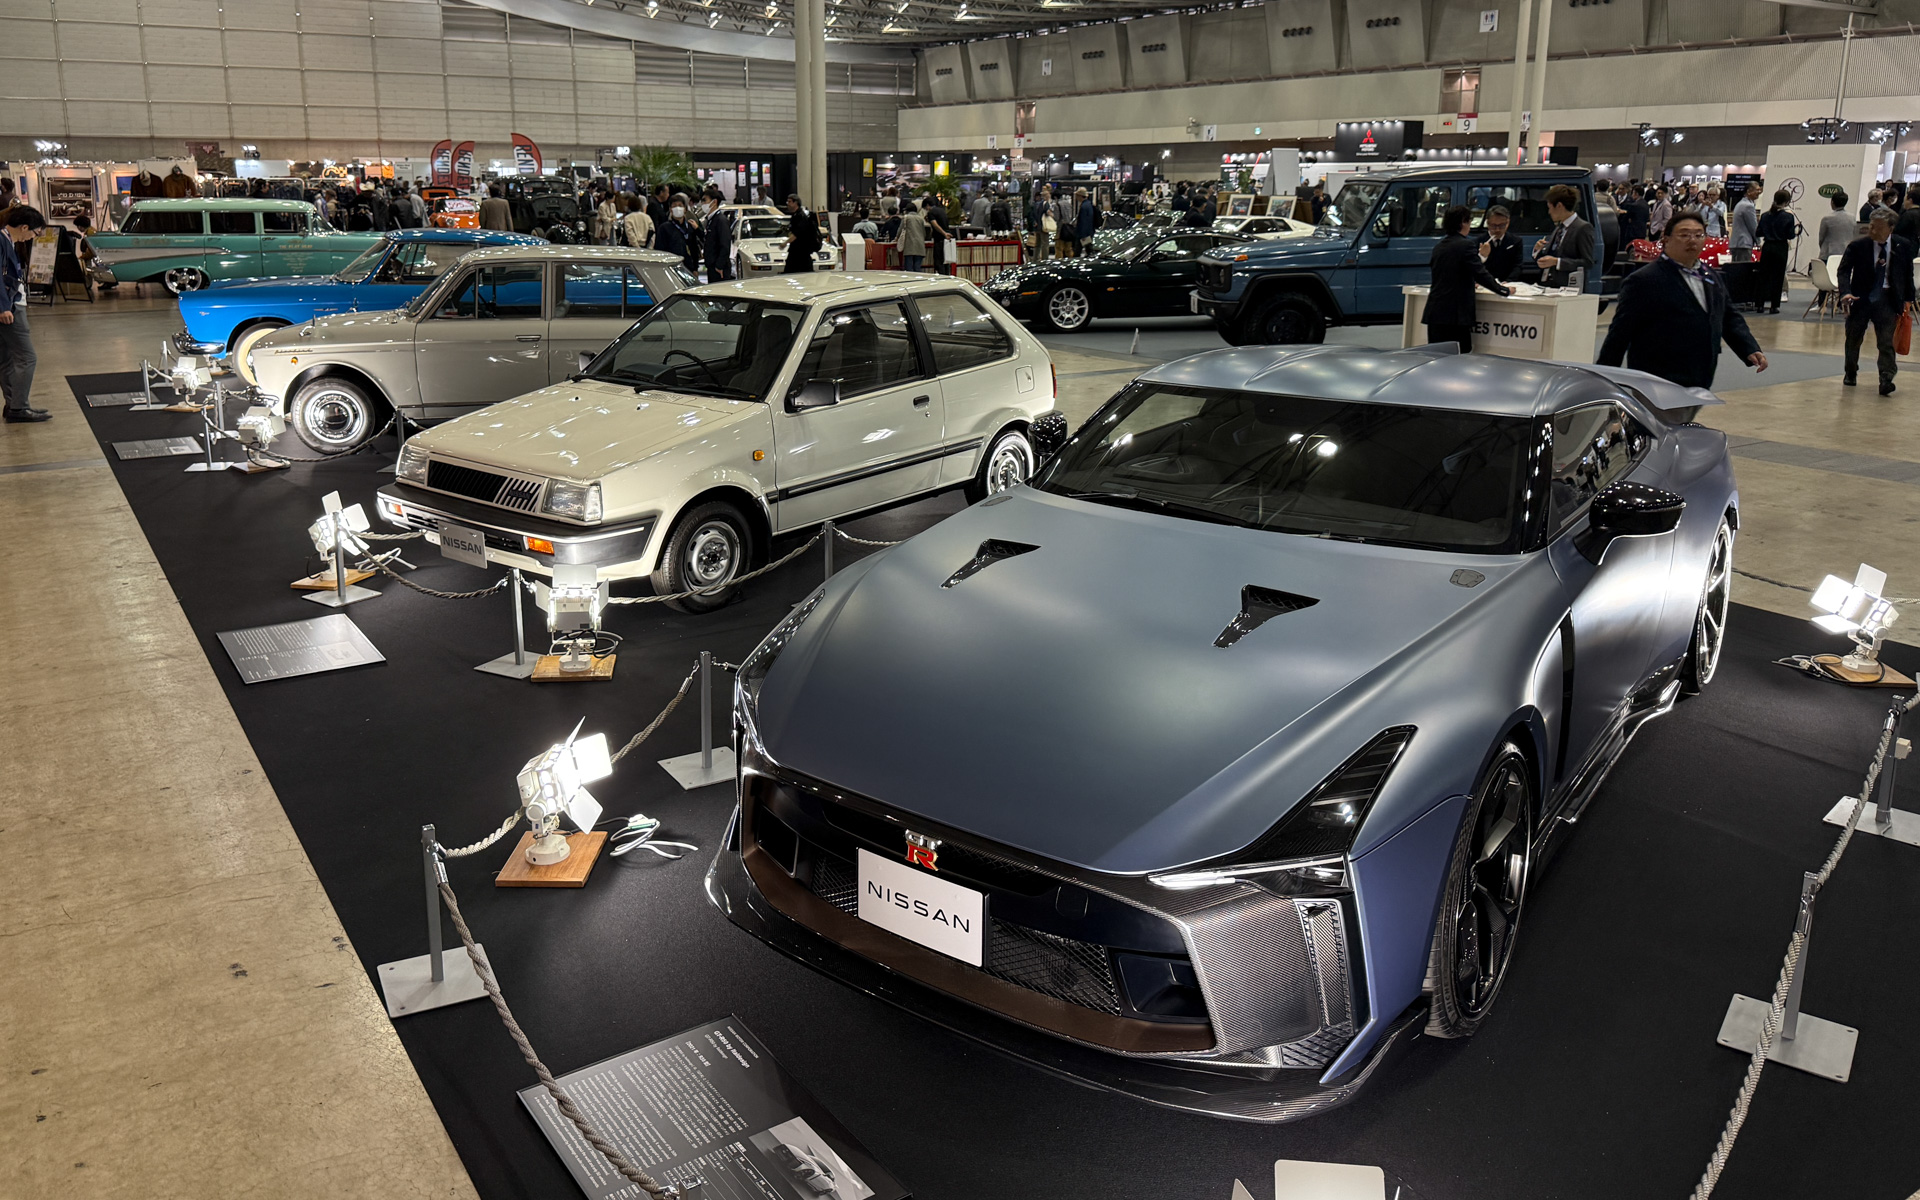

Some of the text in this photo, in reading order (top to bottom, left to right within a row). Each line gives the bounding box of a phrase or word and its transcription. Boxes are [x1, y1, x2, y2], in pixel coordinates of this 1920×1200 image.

[1464, 119, 1470, 131] 9
[1471, 322, 1537, 339] ES TOKYO
[443, 536, 482, 555] NISSAN
[906, 842, 939, 871] R
[868, 880, 970, 933] NISSAN
